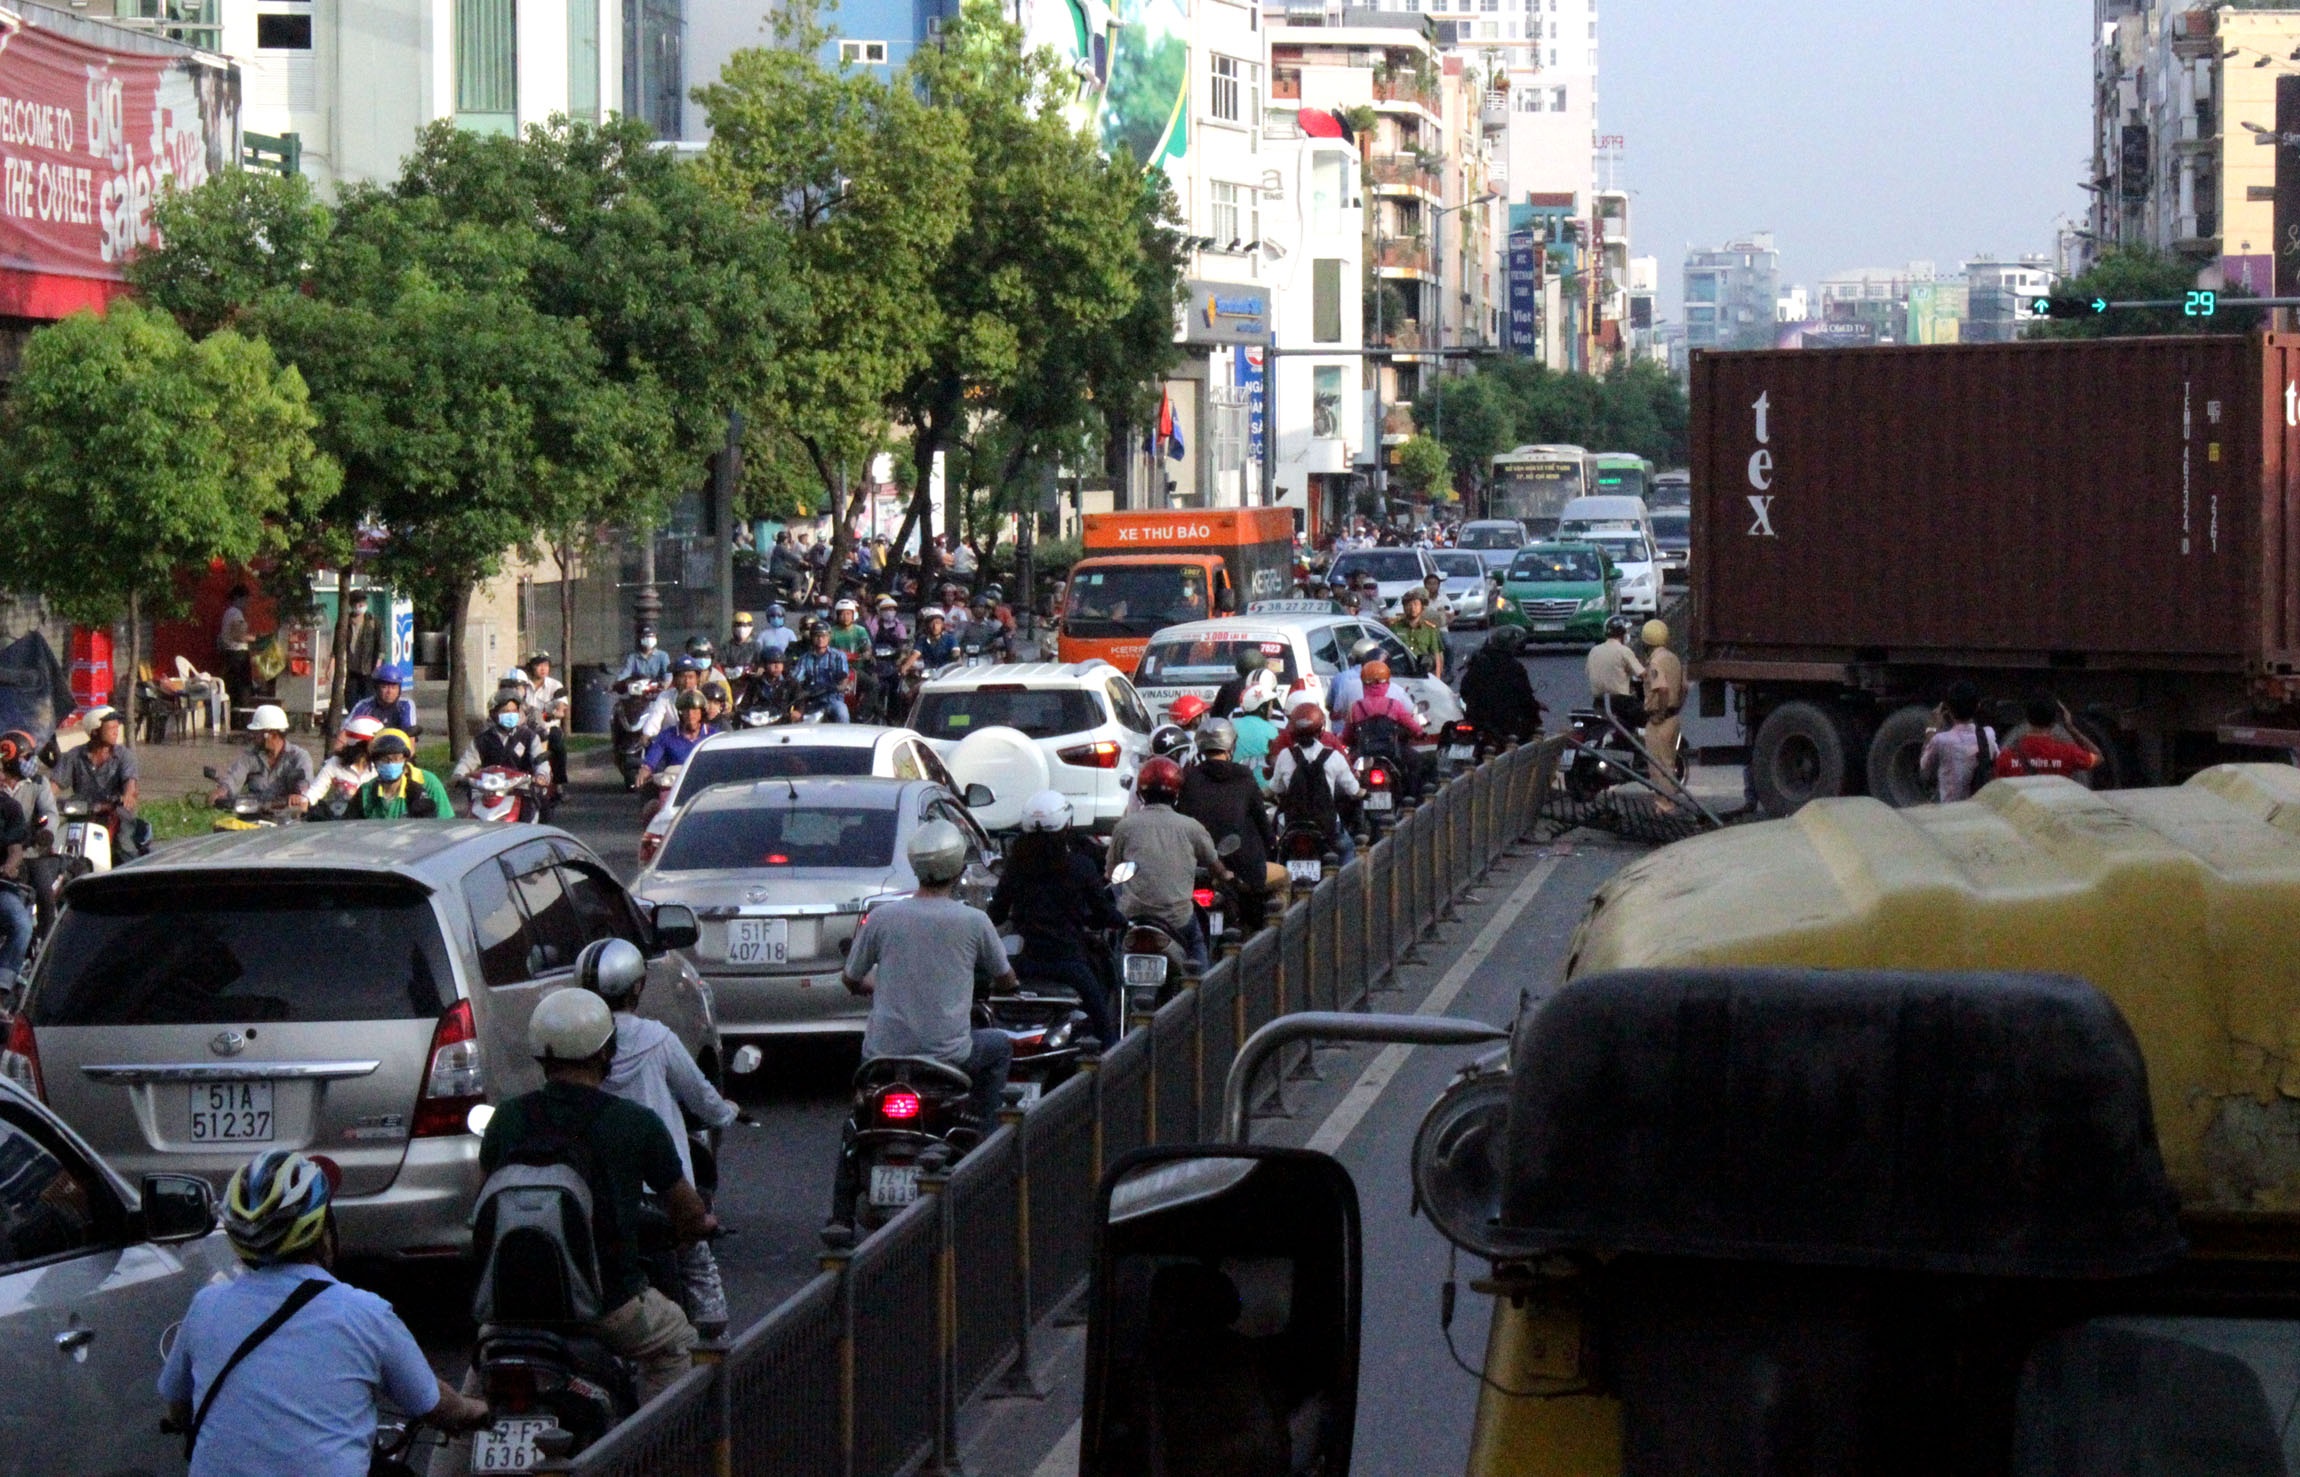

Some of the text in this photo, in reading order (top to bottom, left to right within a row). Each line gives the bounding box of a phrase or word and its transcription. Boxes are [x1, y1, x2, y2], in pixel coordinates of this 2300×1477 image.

[56, 108, 73, 152] TO
[5, 156, 92, 225] THE OUTLET
[100, 143, 151, 263] sale
[2184, 291, 2215, 316] 29
[2285, 379, 2300, 427] t
[1119, 527, 1138, 541] XE
[1142, 525, 1174, 539] THƯ
[1110, 646, 1147, 654] KERR
[741, 922, 773, 942] 51F
[729, 942, 785, 961] 407.18
[209, 1084, 253, 1110] 51A
[192, 1111, 271, 1138] 512.37
[485, 1446, 537, 1468] 6361
